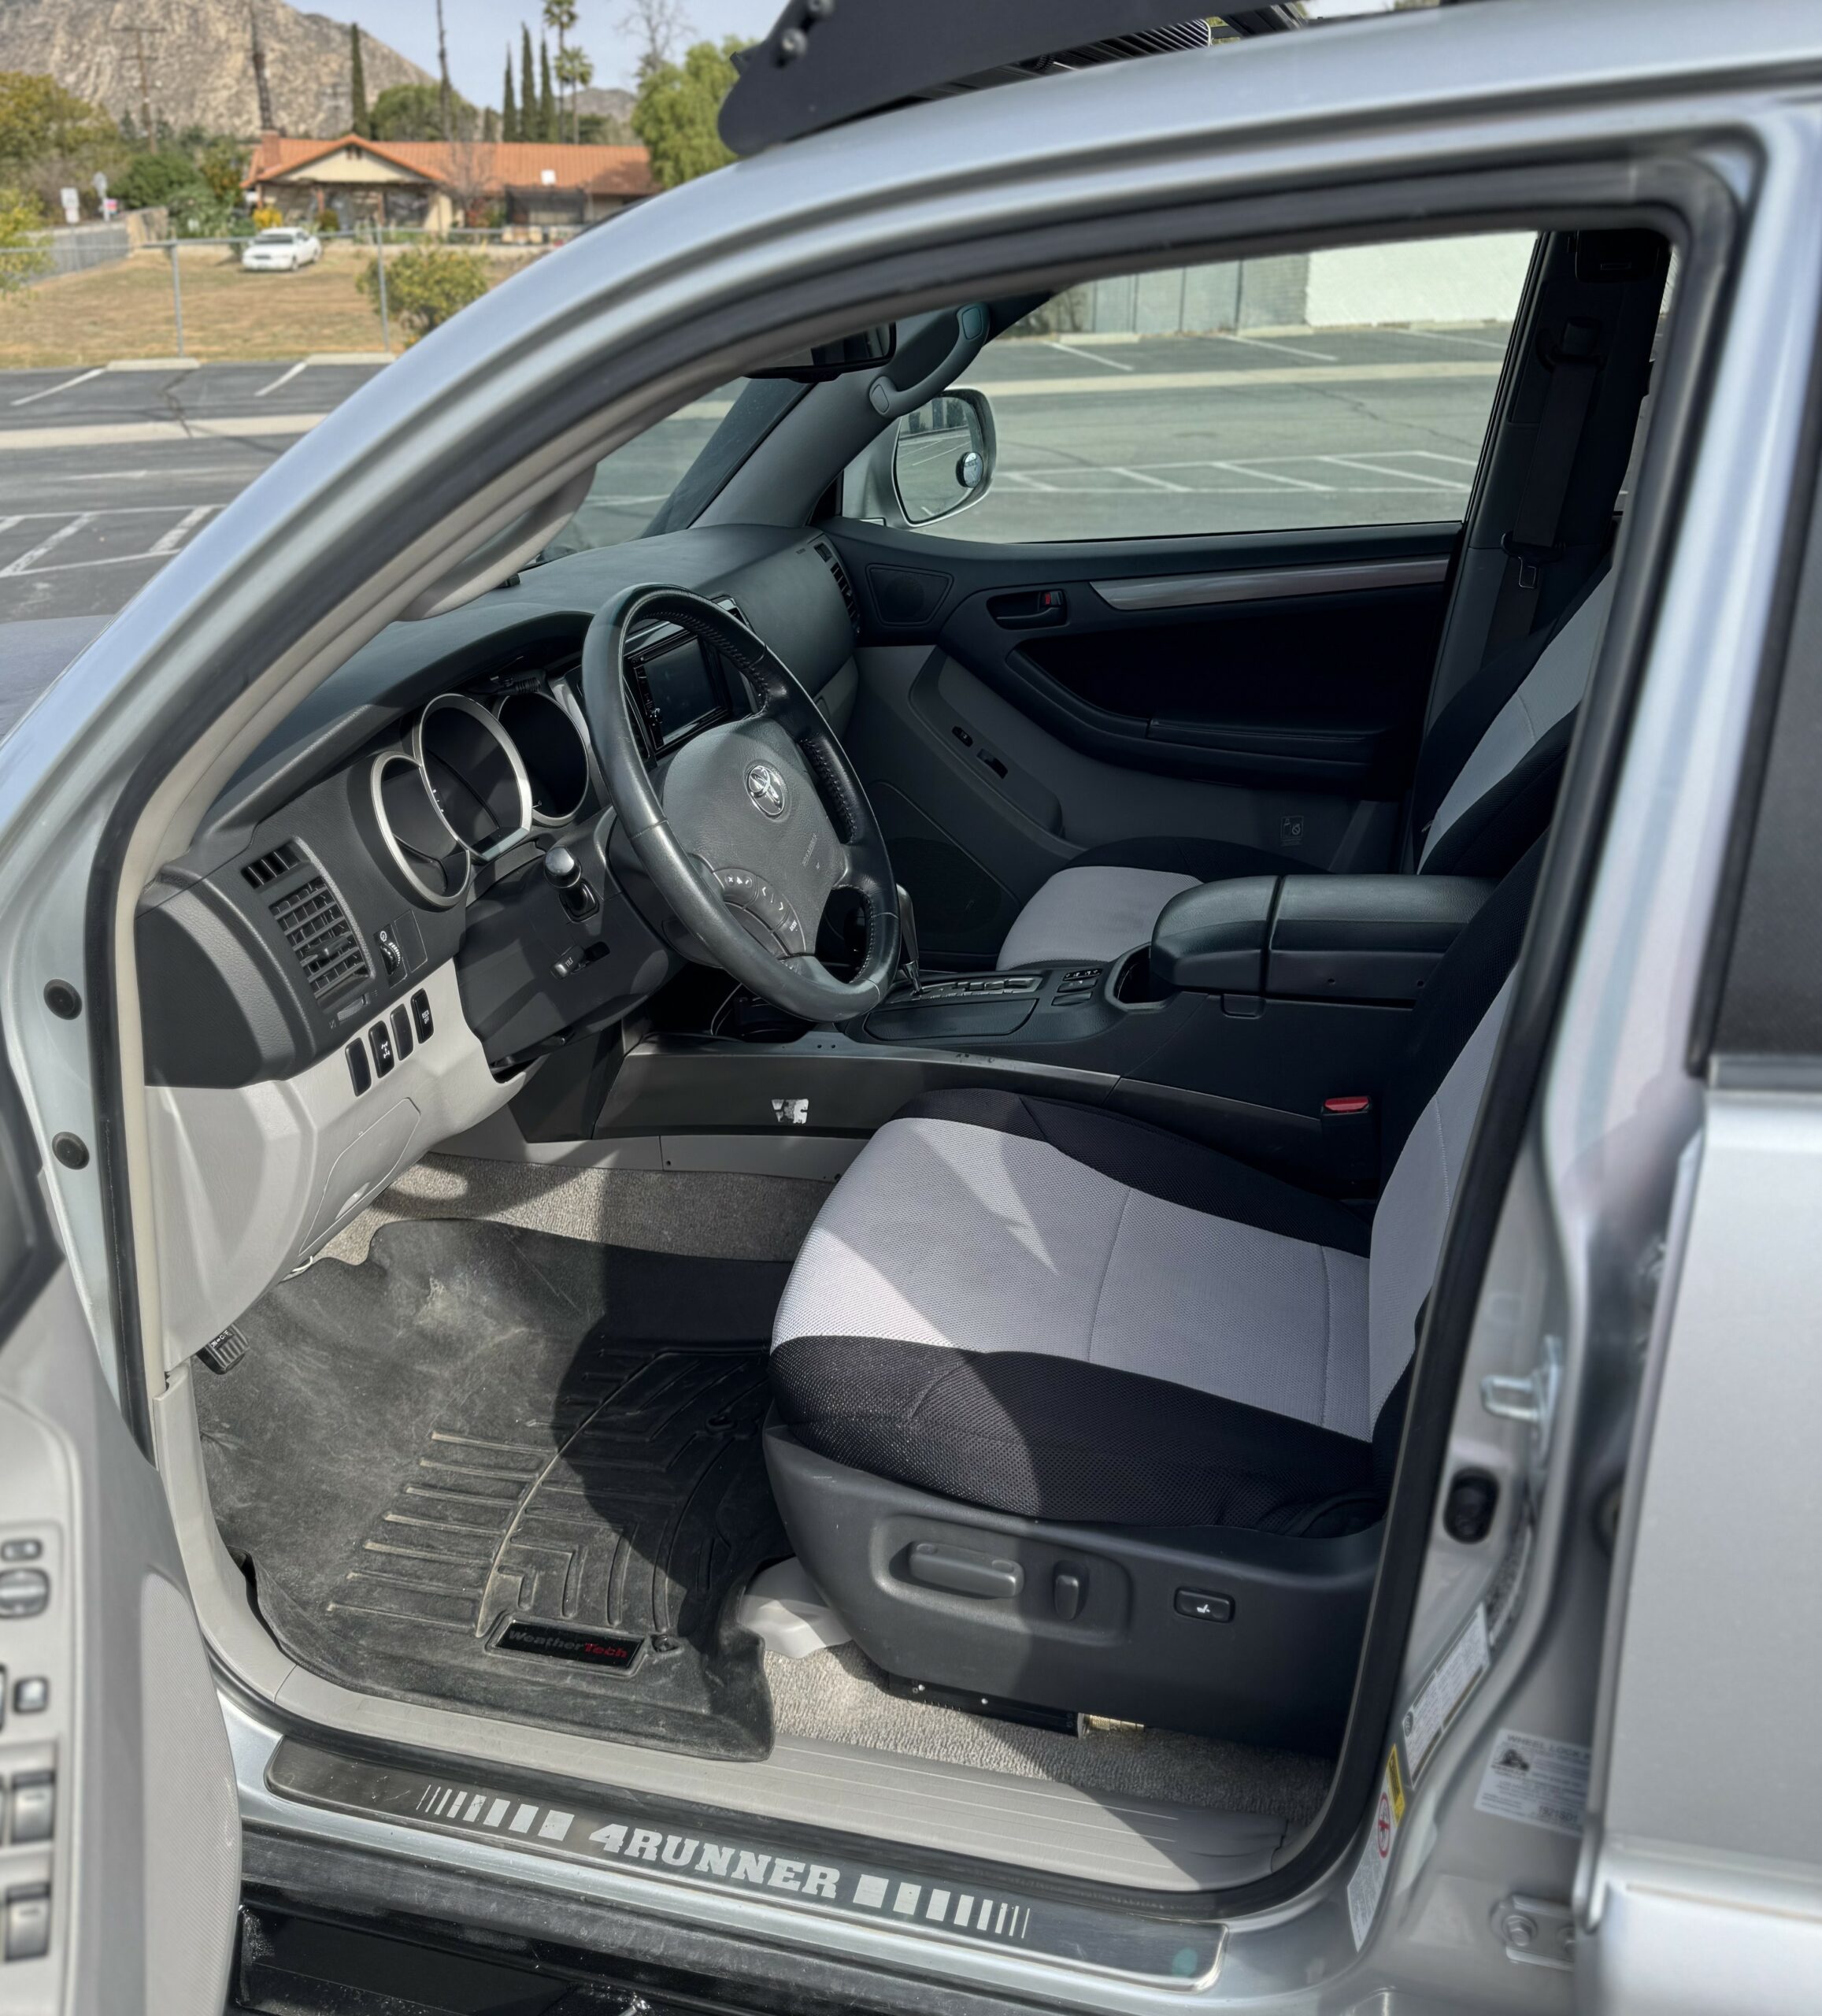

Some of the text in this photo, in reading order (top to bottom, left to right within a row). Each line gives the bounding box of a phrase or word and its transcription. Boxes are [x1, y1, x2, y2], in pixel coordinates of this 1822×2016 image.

[509, 1630, 628, 1658] WeatherTech
[1507, 1734, 1544, 1748] WHEEL
[589, 1823, 841, 1899] 4RUNNER
